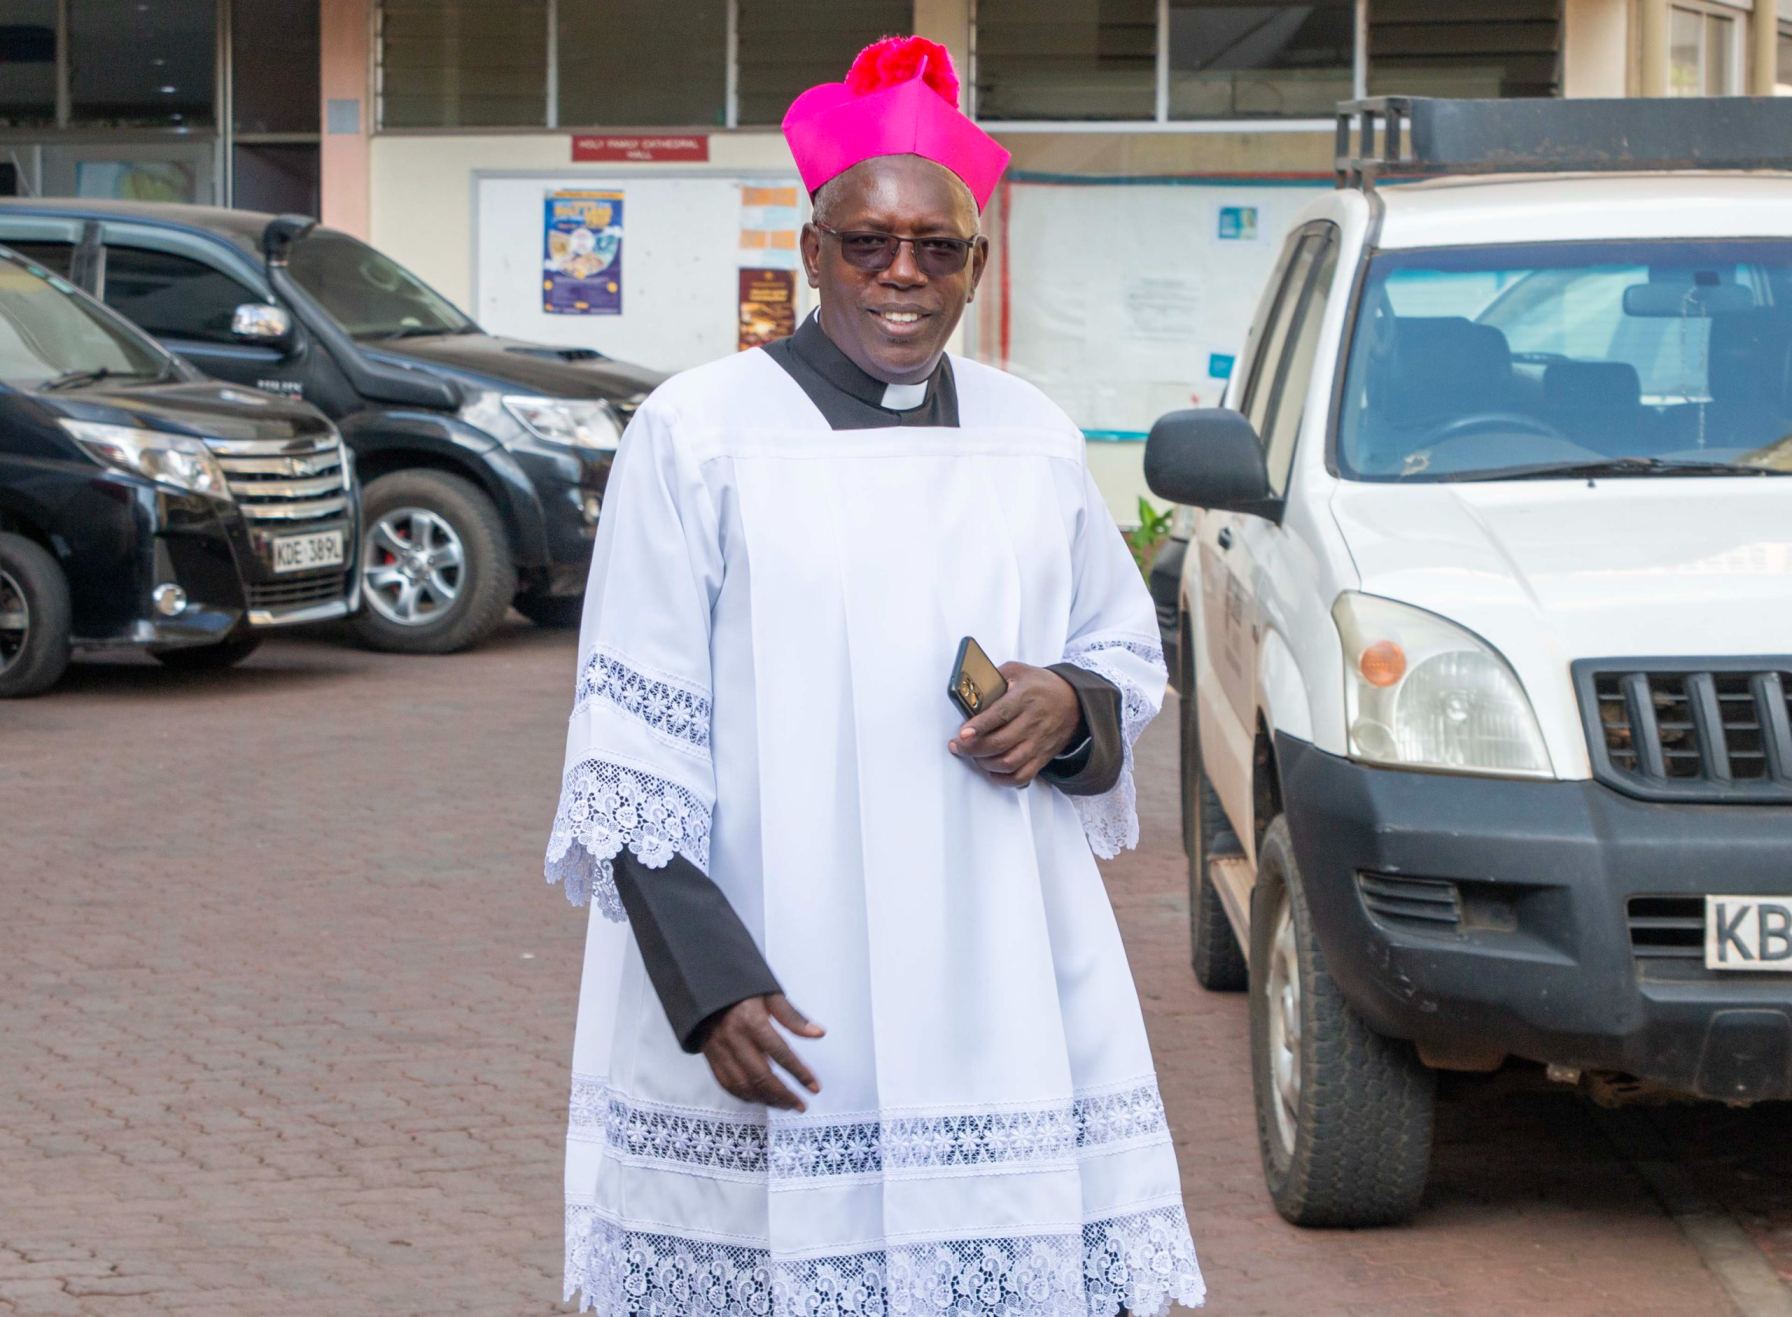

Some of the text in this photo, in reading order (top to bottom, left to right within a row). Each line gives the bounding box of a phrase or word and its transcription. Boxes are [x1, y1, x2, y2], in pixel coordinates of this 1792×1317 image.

[276, 535, 342, 566] KDE 389L
[1715, 903, 1792, 962] KB
